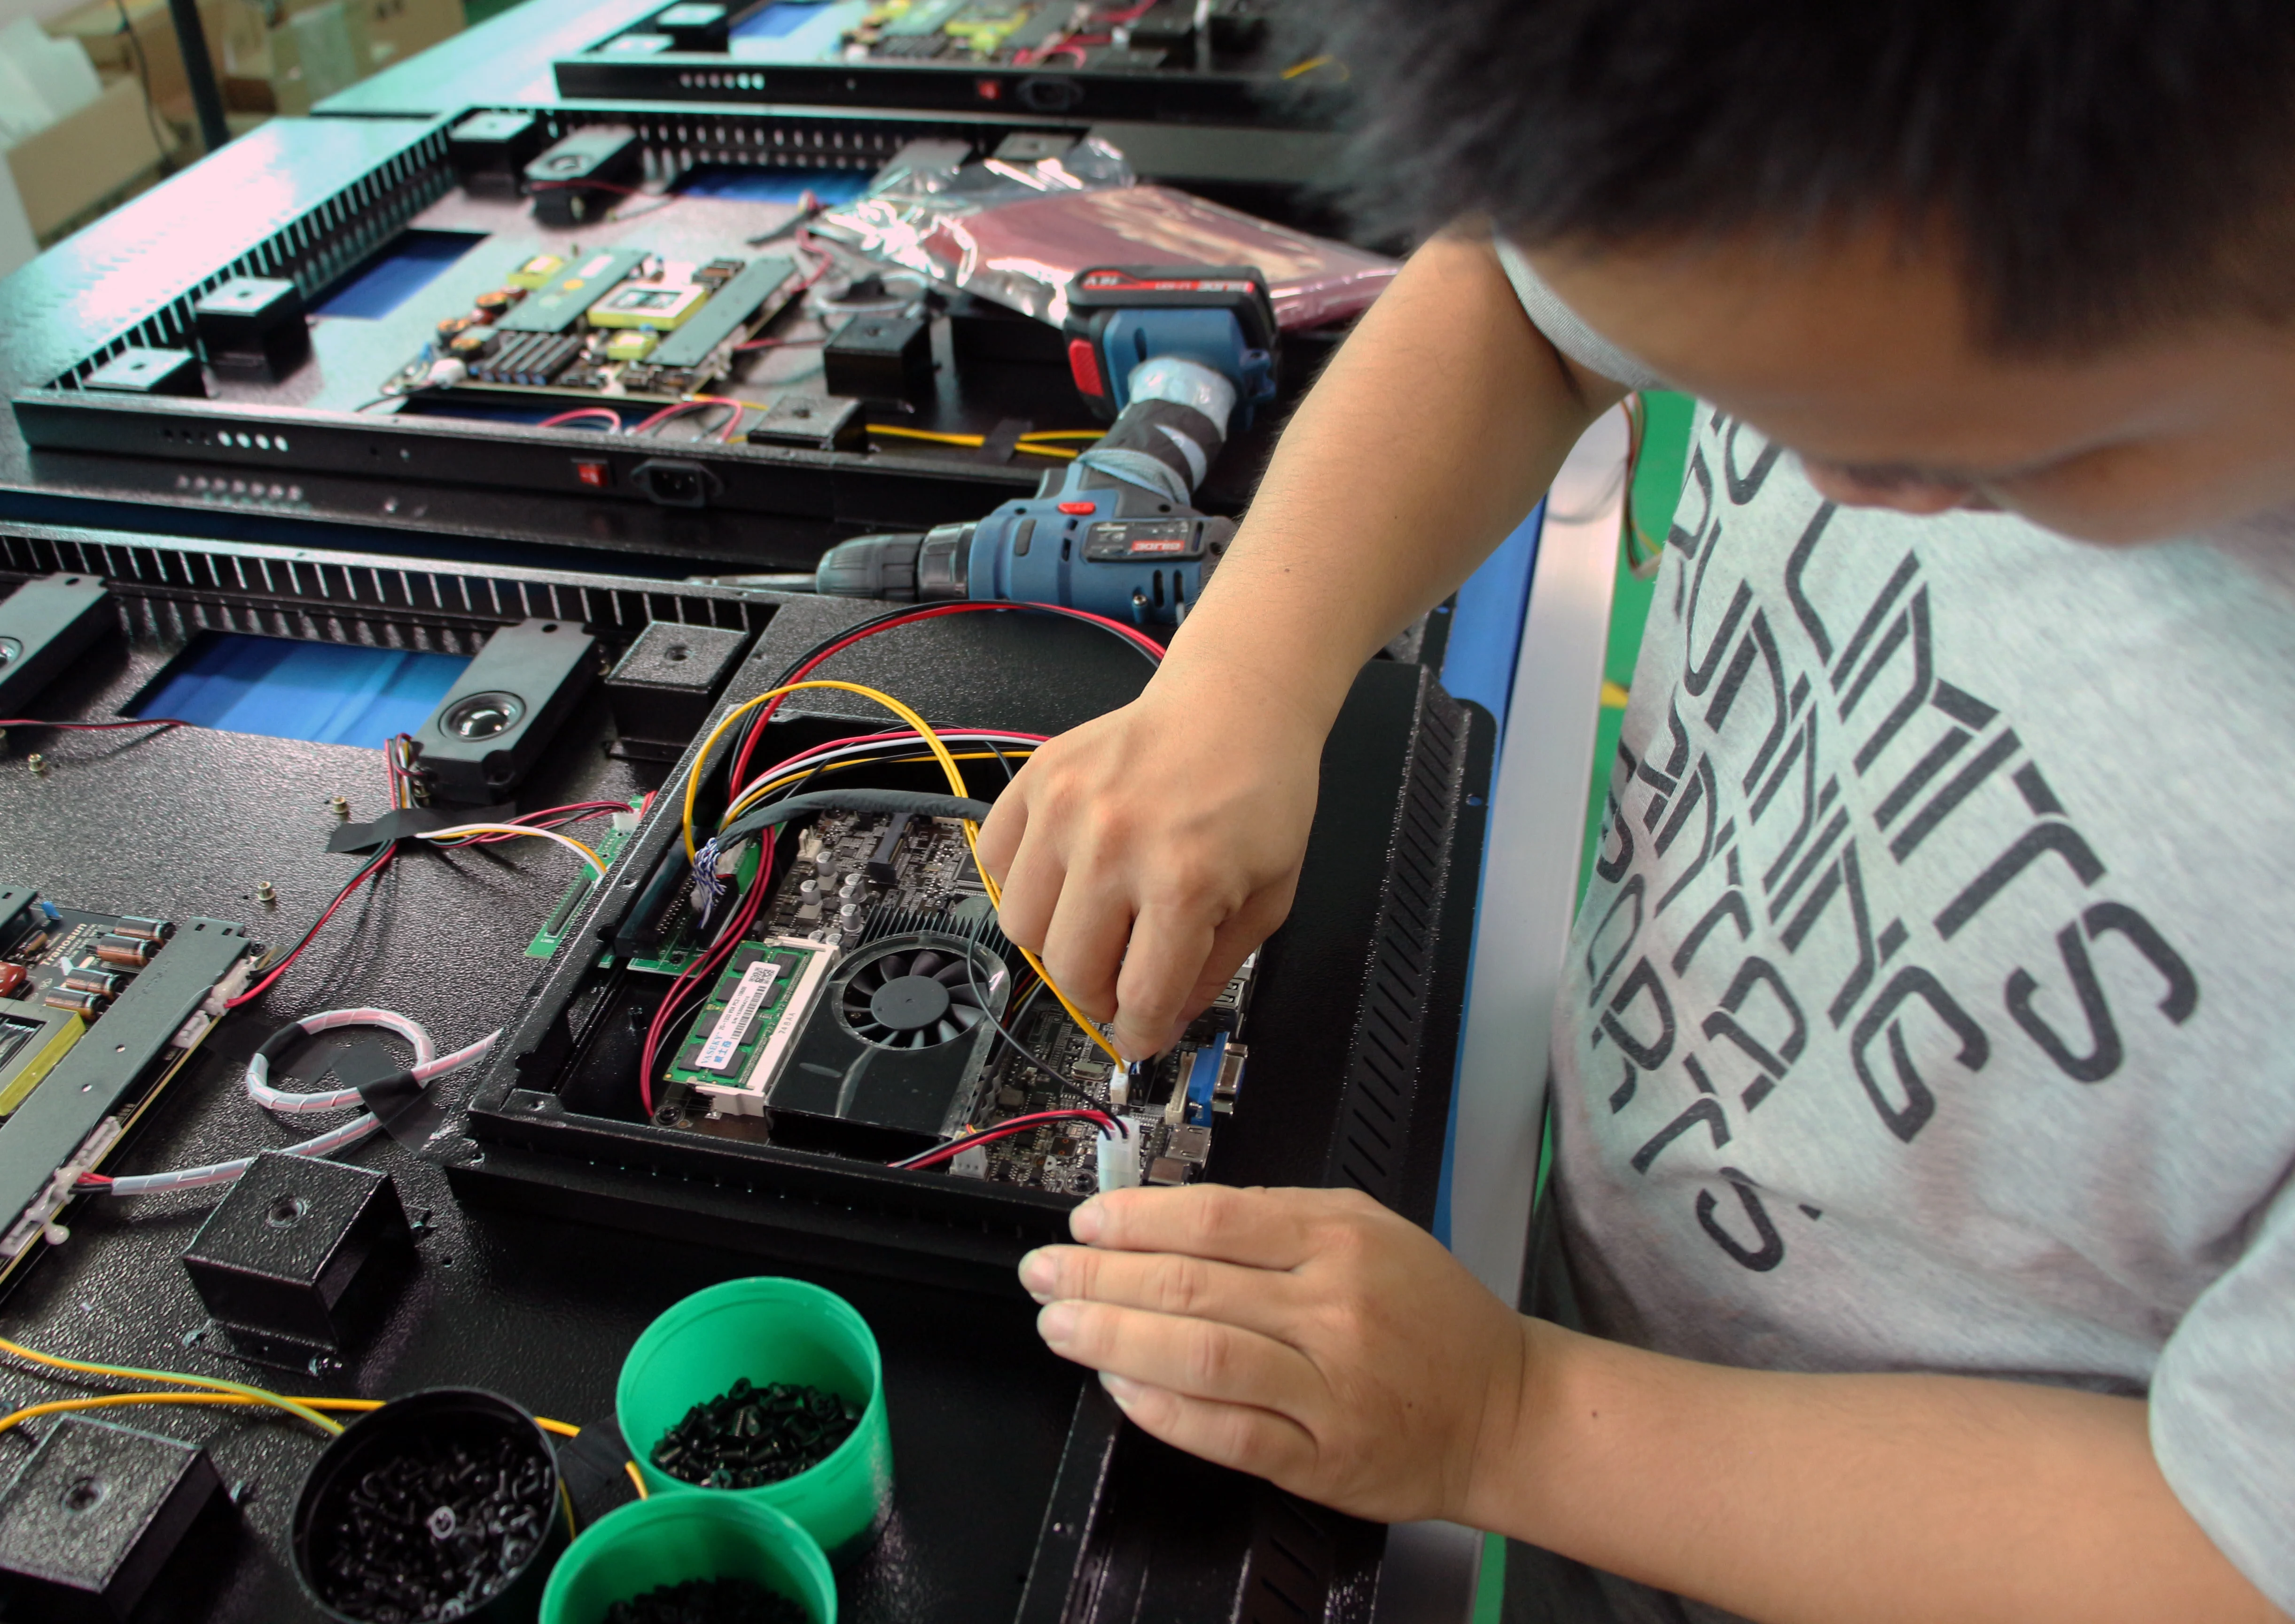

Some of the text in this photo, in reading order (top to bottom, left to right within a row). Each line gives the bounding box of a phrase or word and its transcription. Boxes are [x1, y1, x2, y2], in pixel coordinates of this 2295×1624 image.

[39, 923, 87, 965] Tranosun
[1668, 441, 1991, 1144] RUNNING
[1784, 499, 2199, 1084] LIMITS
[701, 1036, 723, 1064] VASEKY
